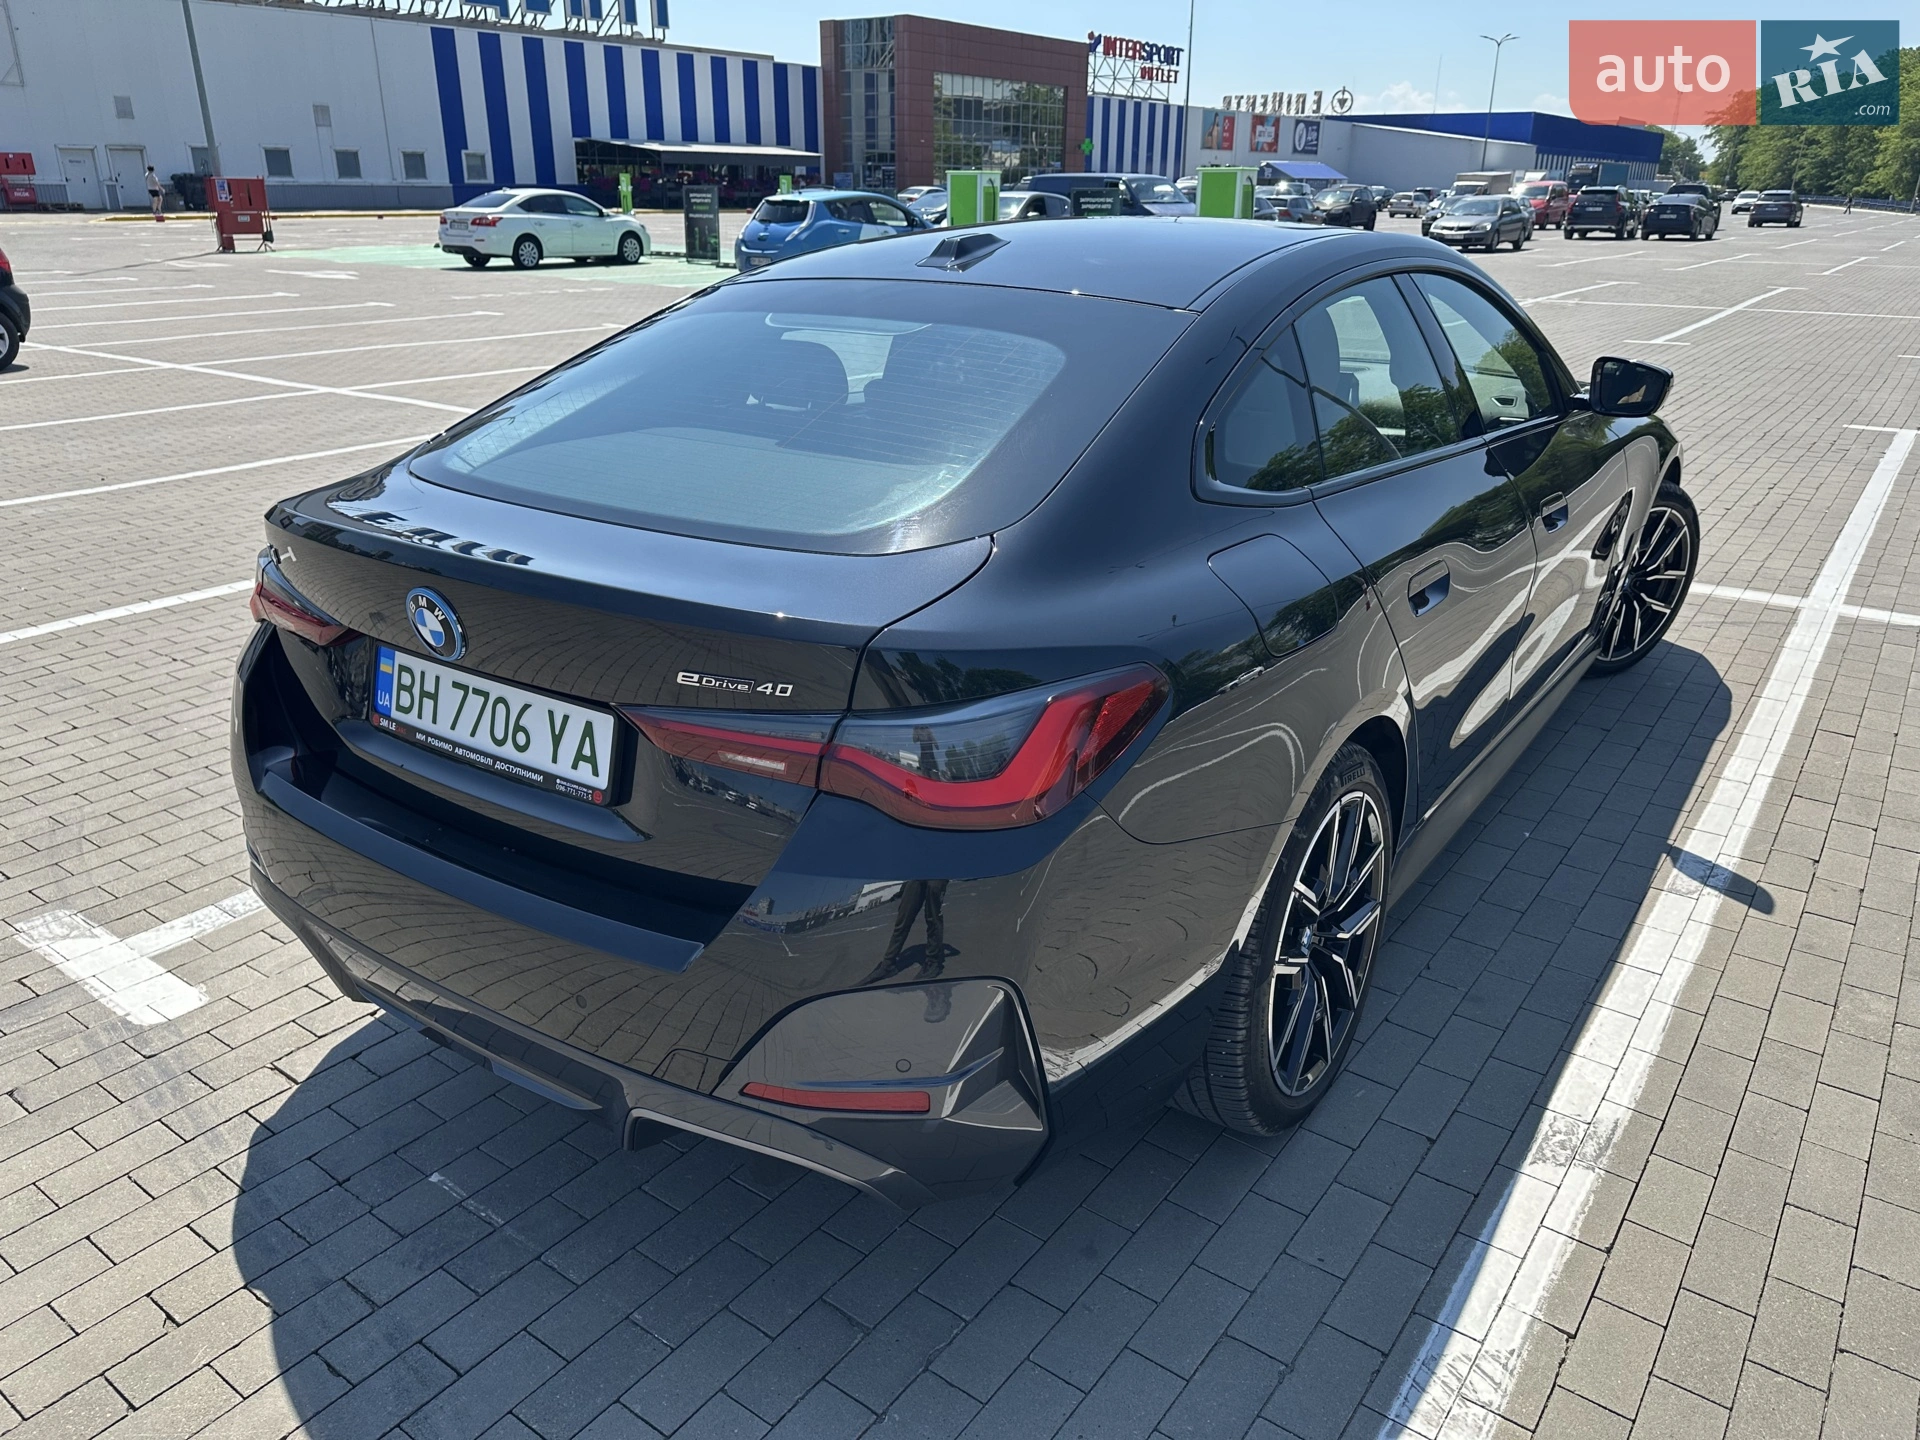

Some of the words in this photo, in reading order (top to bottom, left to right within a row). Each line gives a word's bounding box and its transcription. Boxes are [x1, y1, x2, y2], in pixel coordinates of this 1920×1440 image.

[1103, 35, 1184, 66] INTERSPORT
[1140, 65, 1179, 83] OUTLET
[409, 595, 445, 621] BMW
[676, 671, 752, 692] eDrive
[756, 682, 794, 697] 40
[378, 690, 391, 709] UA
[395, 663, 440, 725] BH
[450, 681, 532, 753] 7706
[547, 709, 600, 778] YA
[415, 731, 426, 742] МИ
[427, 736, 453, 752] РОБИМО
[454, 746, 493, 766] АВТОМОБІЛІ
[494, 760, 544, 783] ДОСТУПНИМИ
[1340, 761, 1366, 788] PIRELLI
